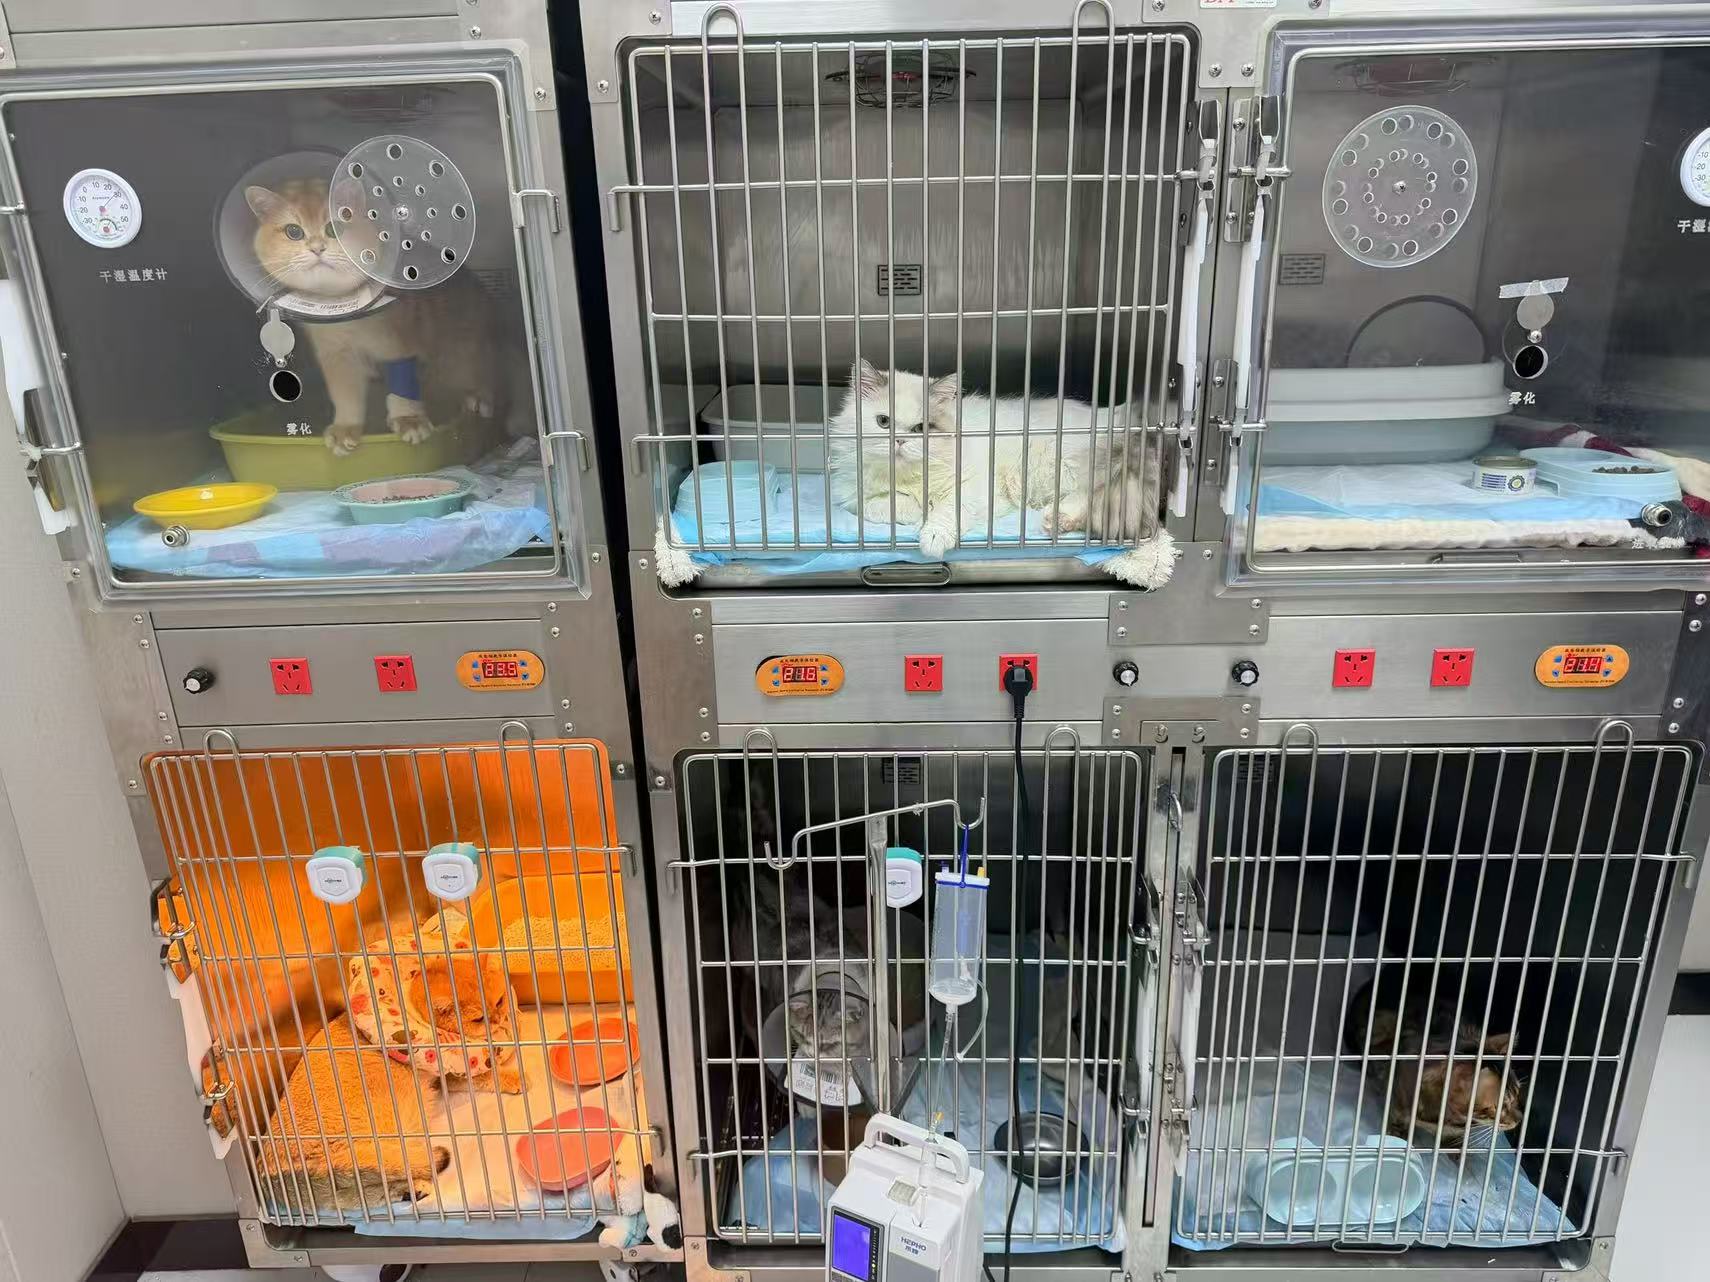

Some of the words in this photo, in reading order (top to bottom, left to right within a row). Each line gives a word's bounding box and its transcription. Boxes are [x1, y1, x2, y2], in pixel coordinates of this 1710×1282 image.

[103, 183, 112, 191] 20
[1677, 219, 1710, 233] 干湿
[99, 267, 168, 284] 干湿温度计
[1508, 391, 1536, 405] 雾化
[286, 422, 312, 436] 雾化
